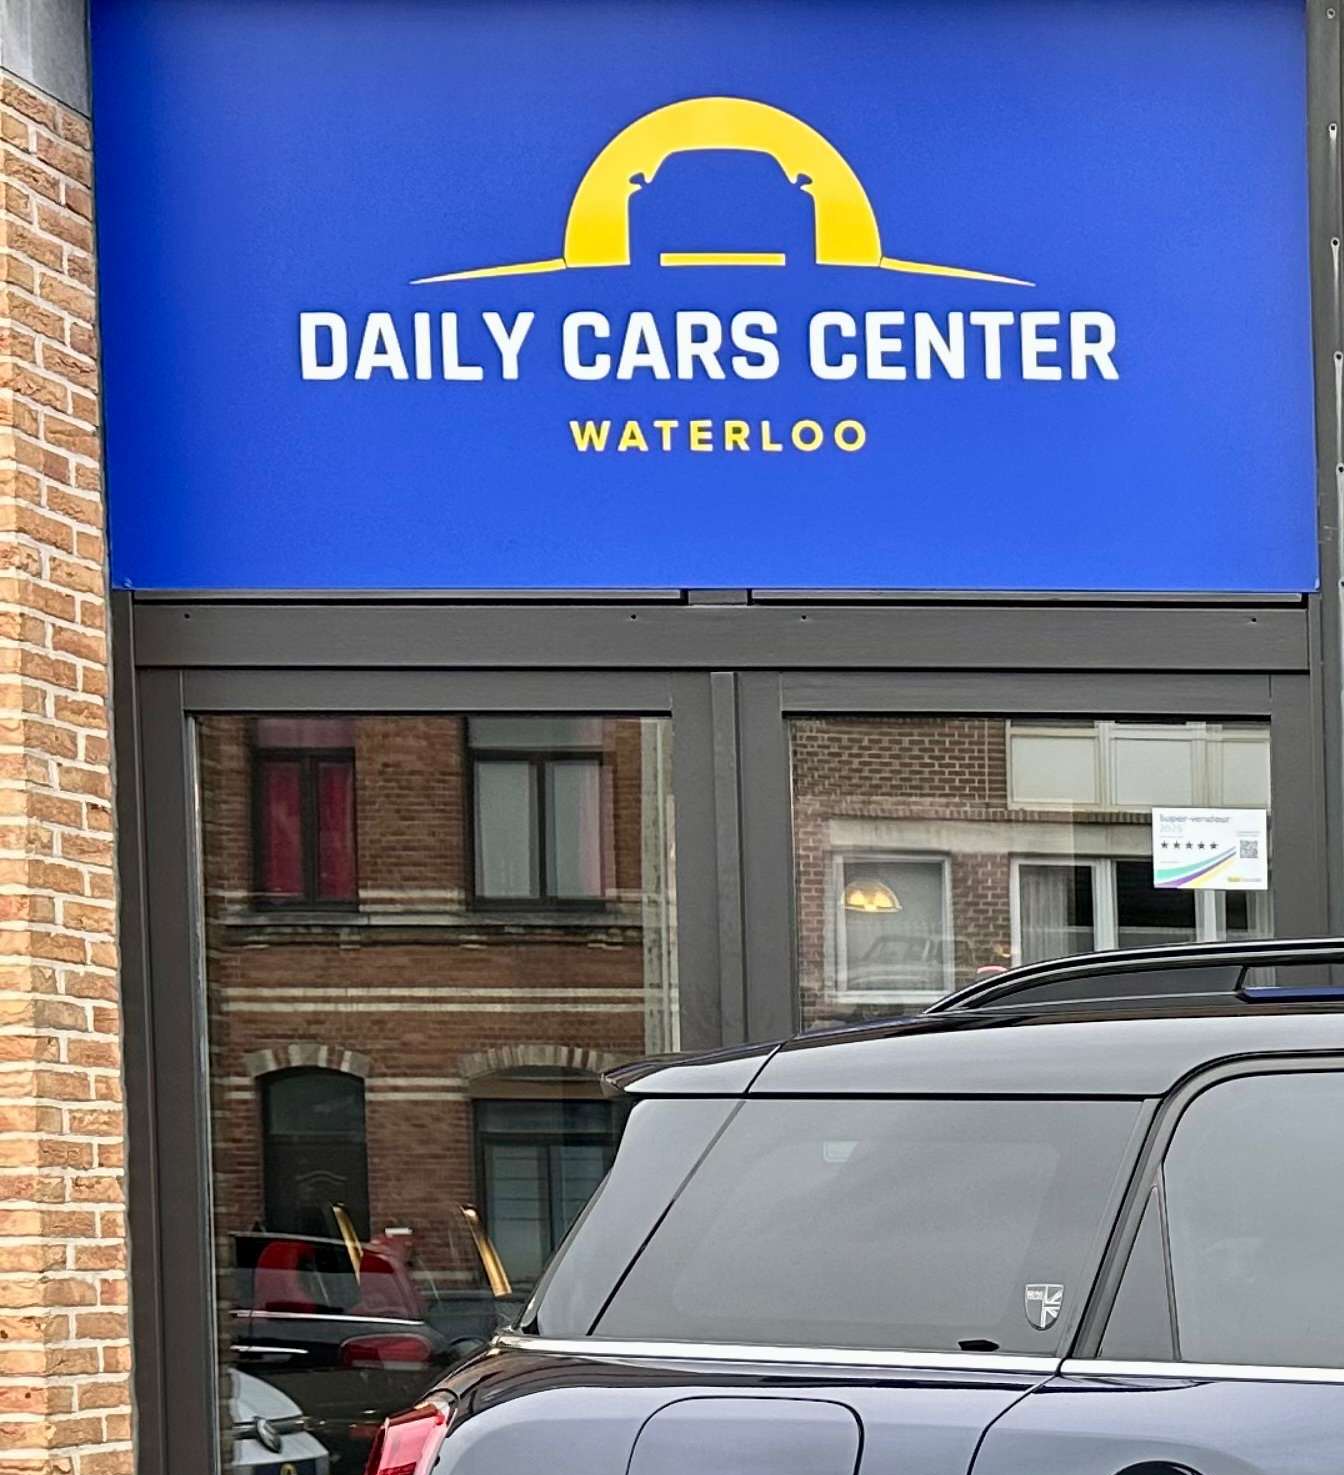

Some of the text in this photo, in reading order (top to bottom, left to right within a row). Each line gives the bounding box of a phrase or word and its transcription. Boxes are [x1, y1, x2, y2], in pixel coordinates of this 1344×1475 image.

[300, 310, 1120, 381] DAILY CARS CENTER
[569, 419, 867, 452] WATERLOO
